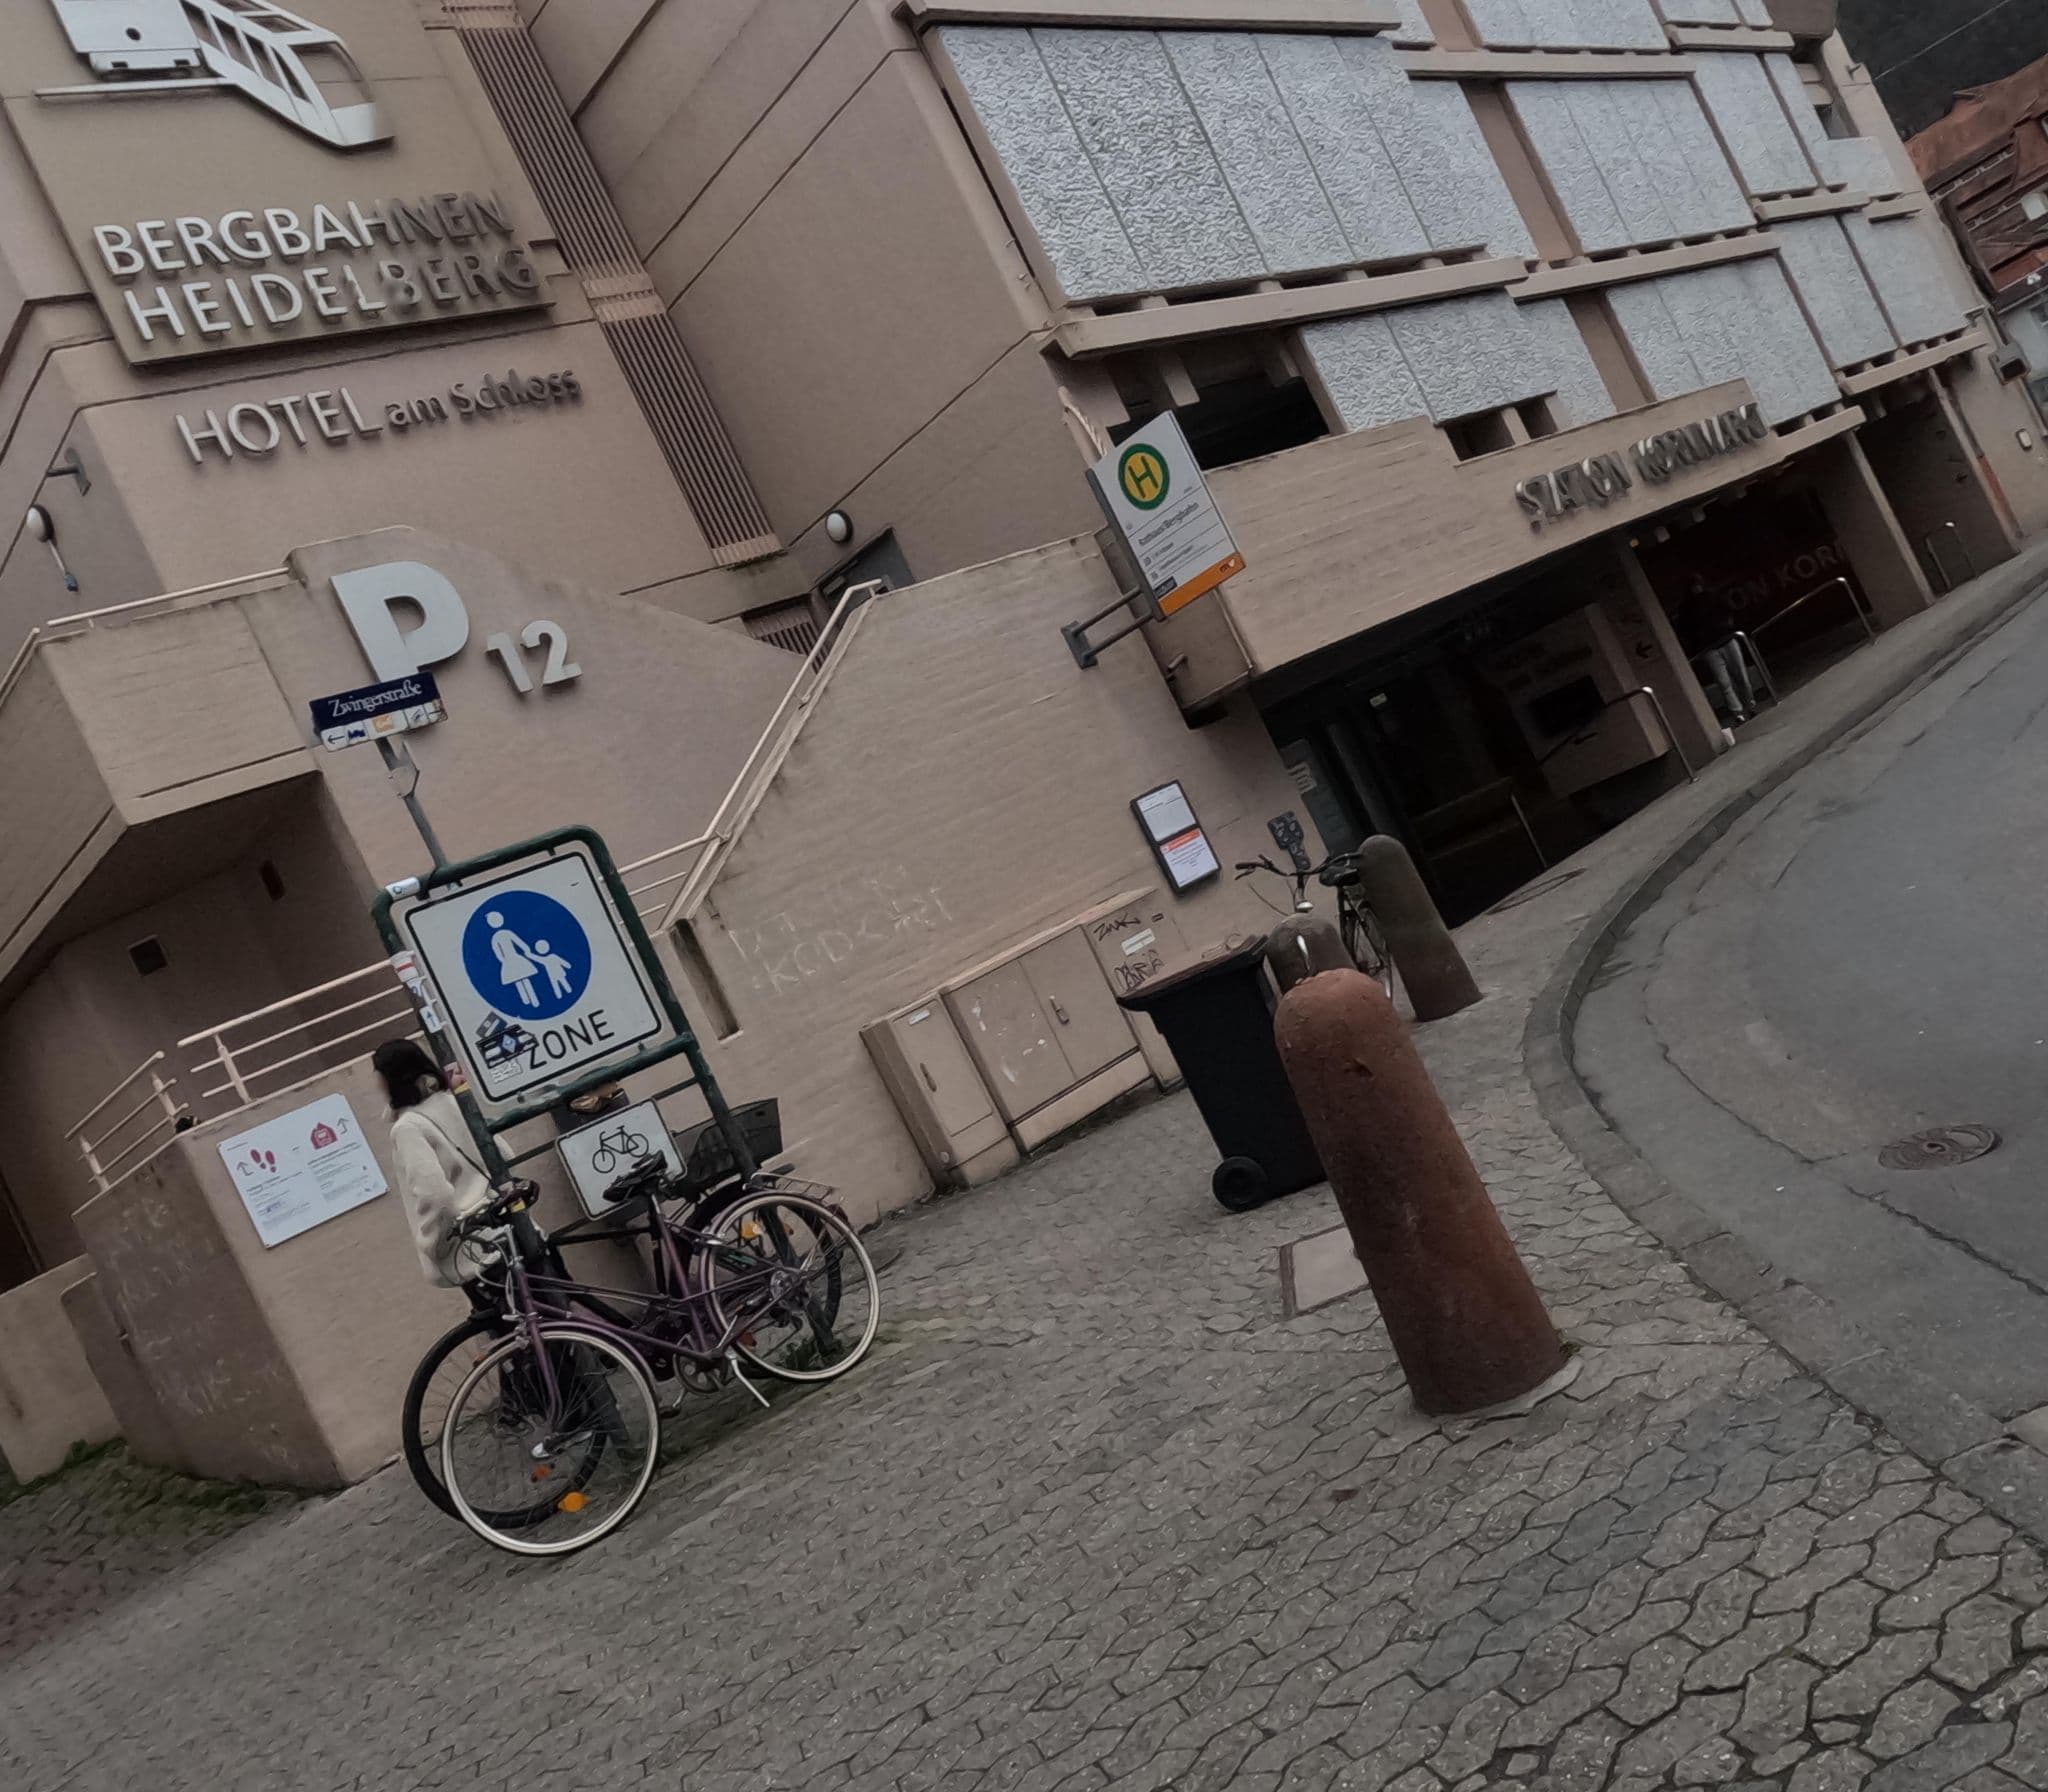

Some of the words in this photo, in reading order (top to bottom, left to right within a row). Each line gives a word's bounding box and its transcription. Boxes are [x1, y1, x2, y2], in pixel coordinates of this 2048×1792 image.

[92, 189, 516, 281] BERGBAHNEN
[123, 248, 541, 342] HEIDELBERG
[174, 385, 384, 465] HOTEL
[384, 394, 449, 434] am
[451, 368, 583, 422] Schloss
[1127, 455, 1160, 499] H
[329, 560, 470, 684] P
[486, 618, 583, 694] 12
[327, 679, 422, 718] Zwingerstraße
[527, 1008, 616, 1071] ZONE
